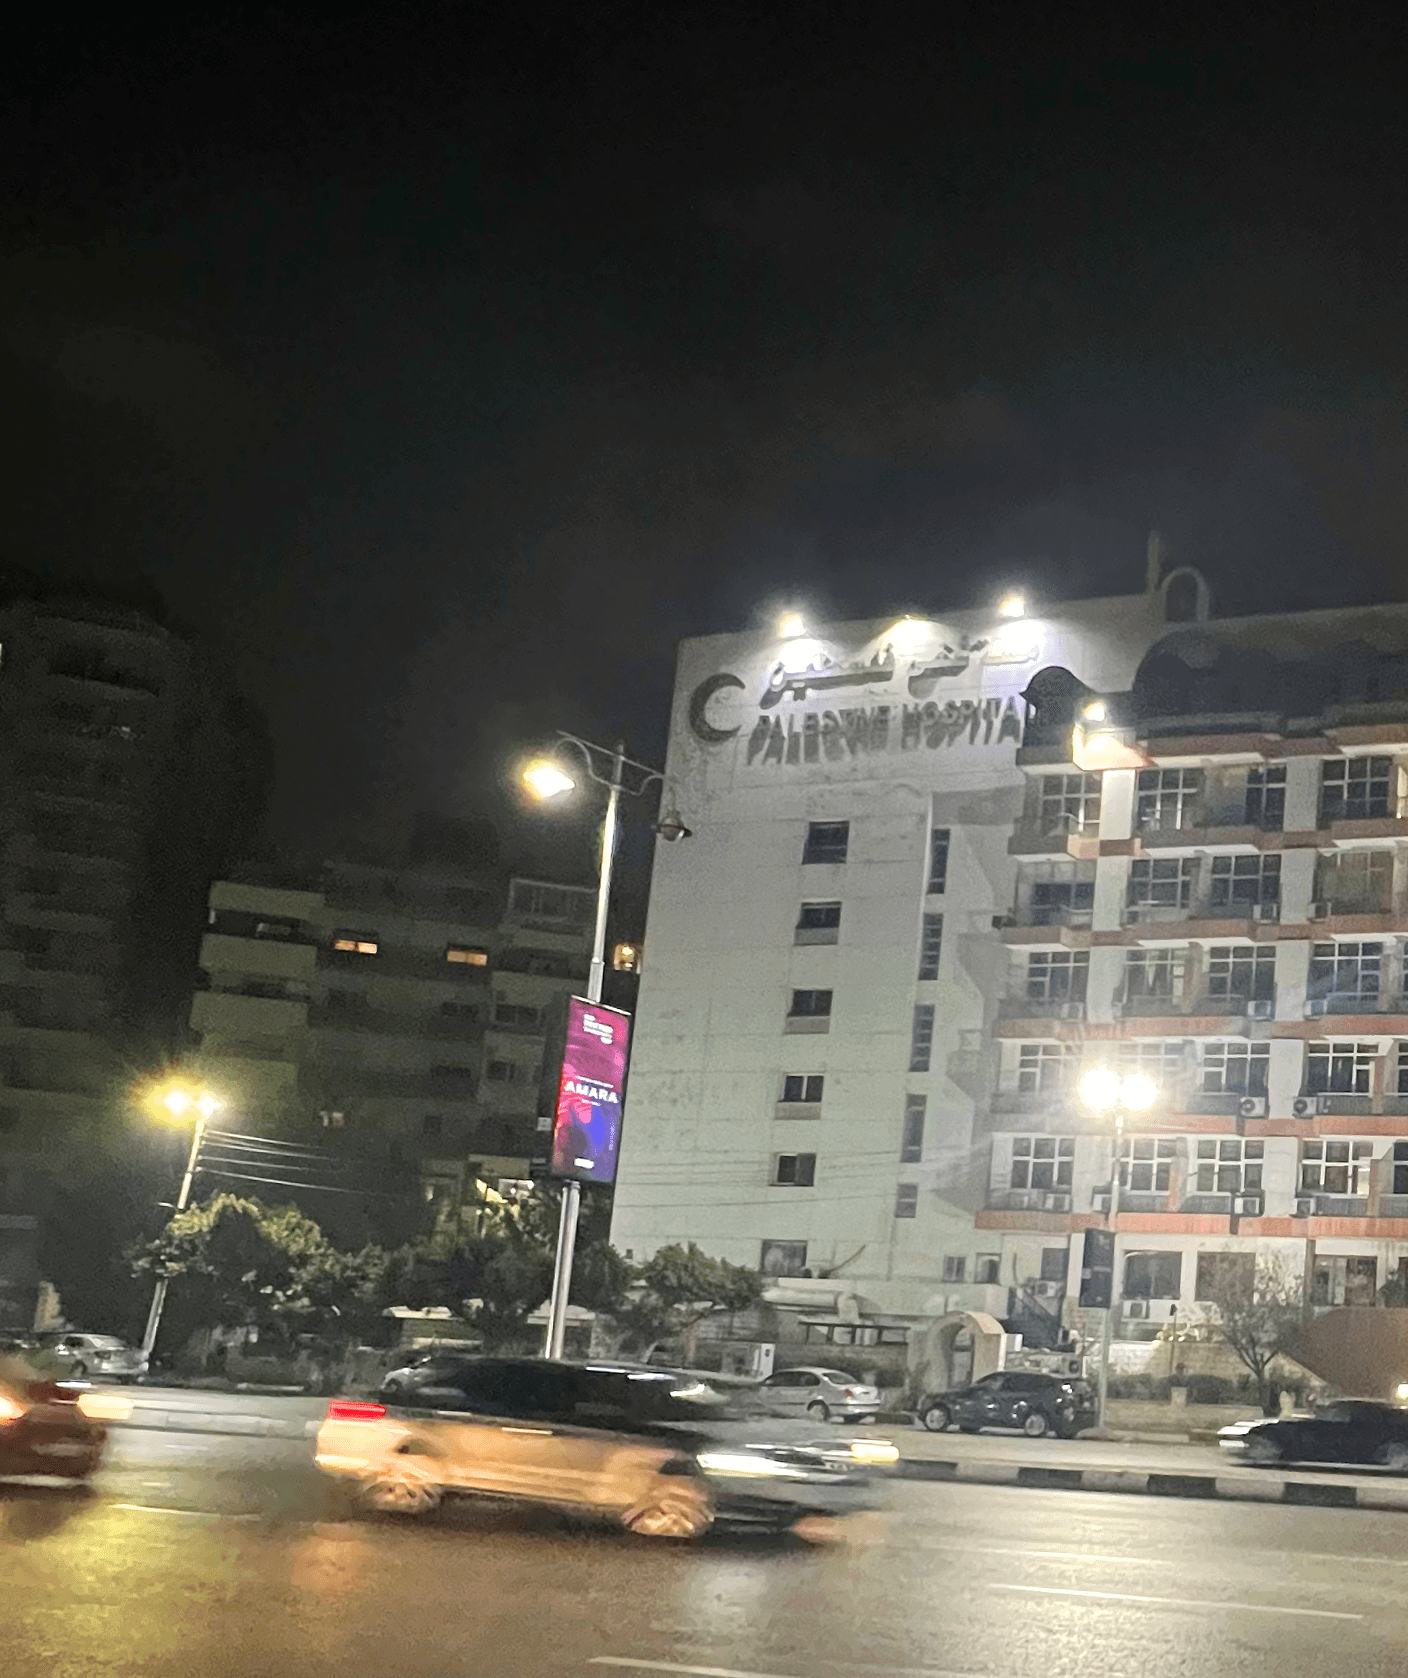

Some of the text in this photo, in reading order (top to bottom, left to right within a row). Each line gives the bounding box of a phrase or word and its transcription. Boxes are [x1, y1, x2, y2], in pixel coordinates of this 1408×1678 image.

[751, 696, 1024, 756] PALESTINE HOSPITA
[564, 1080, 619, 1103] AMARA
